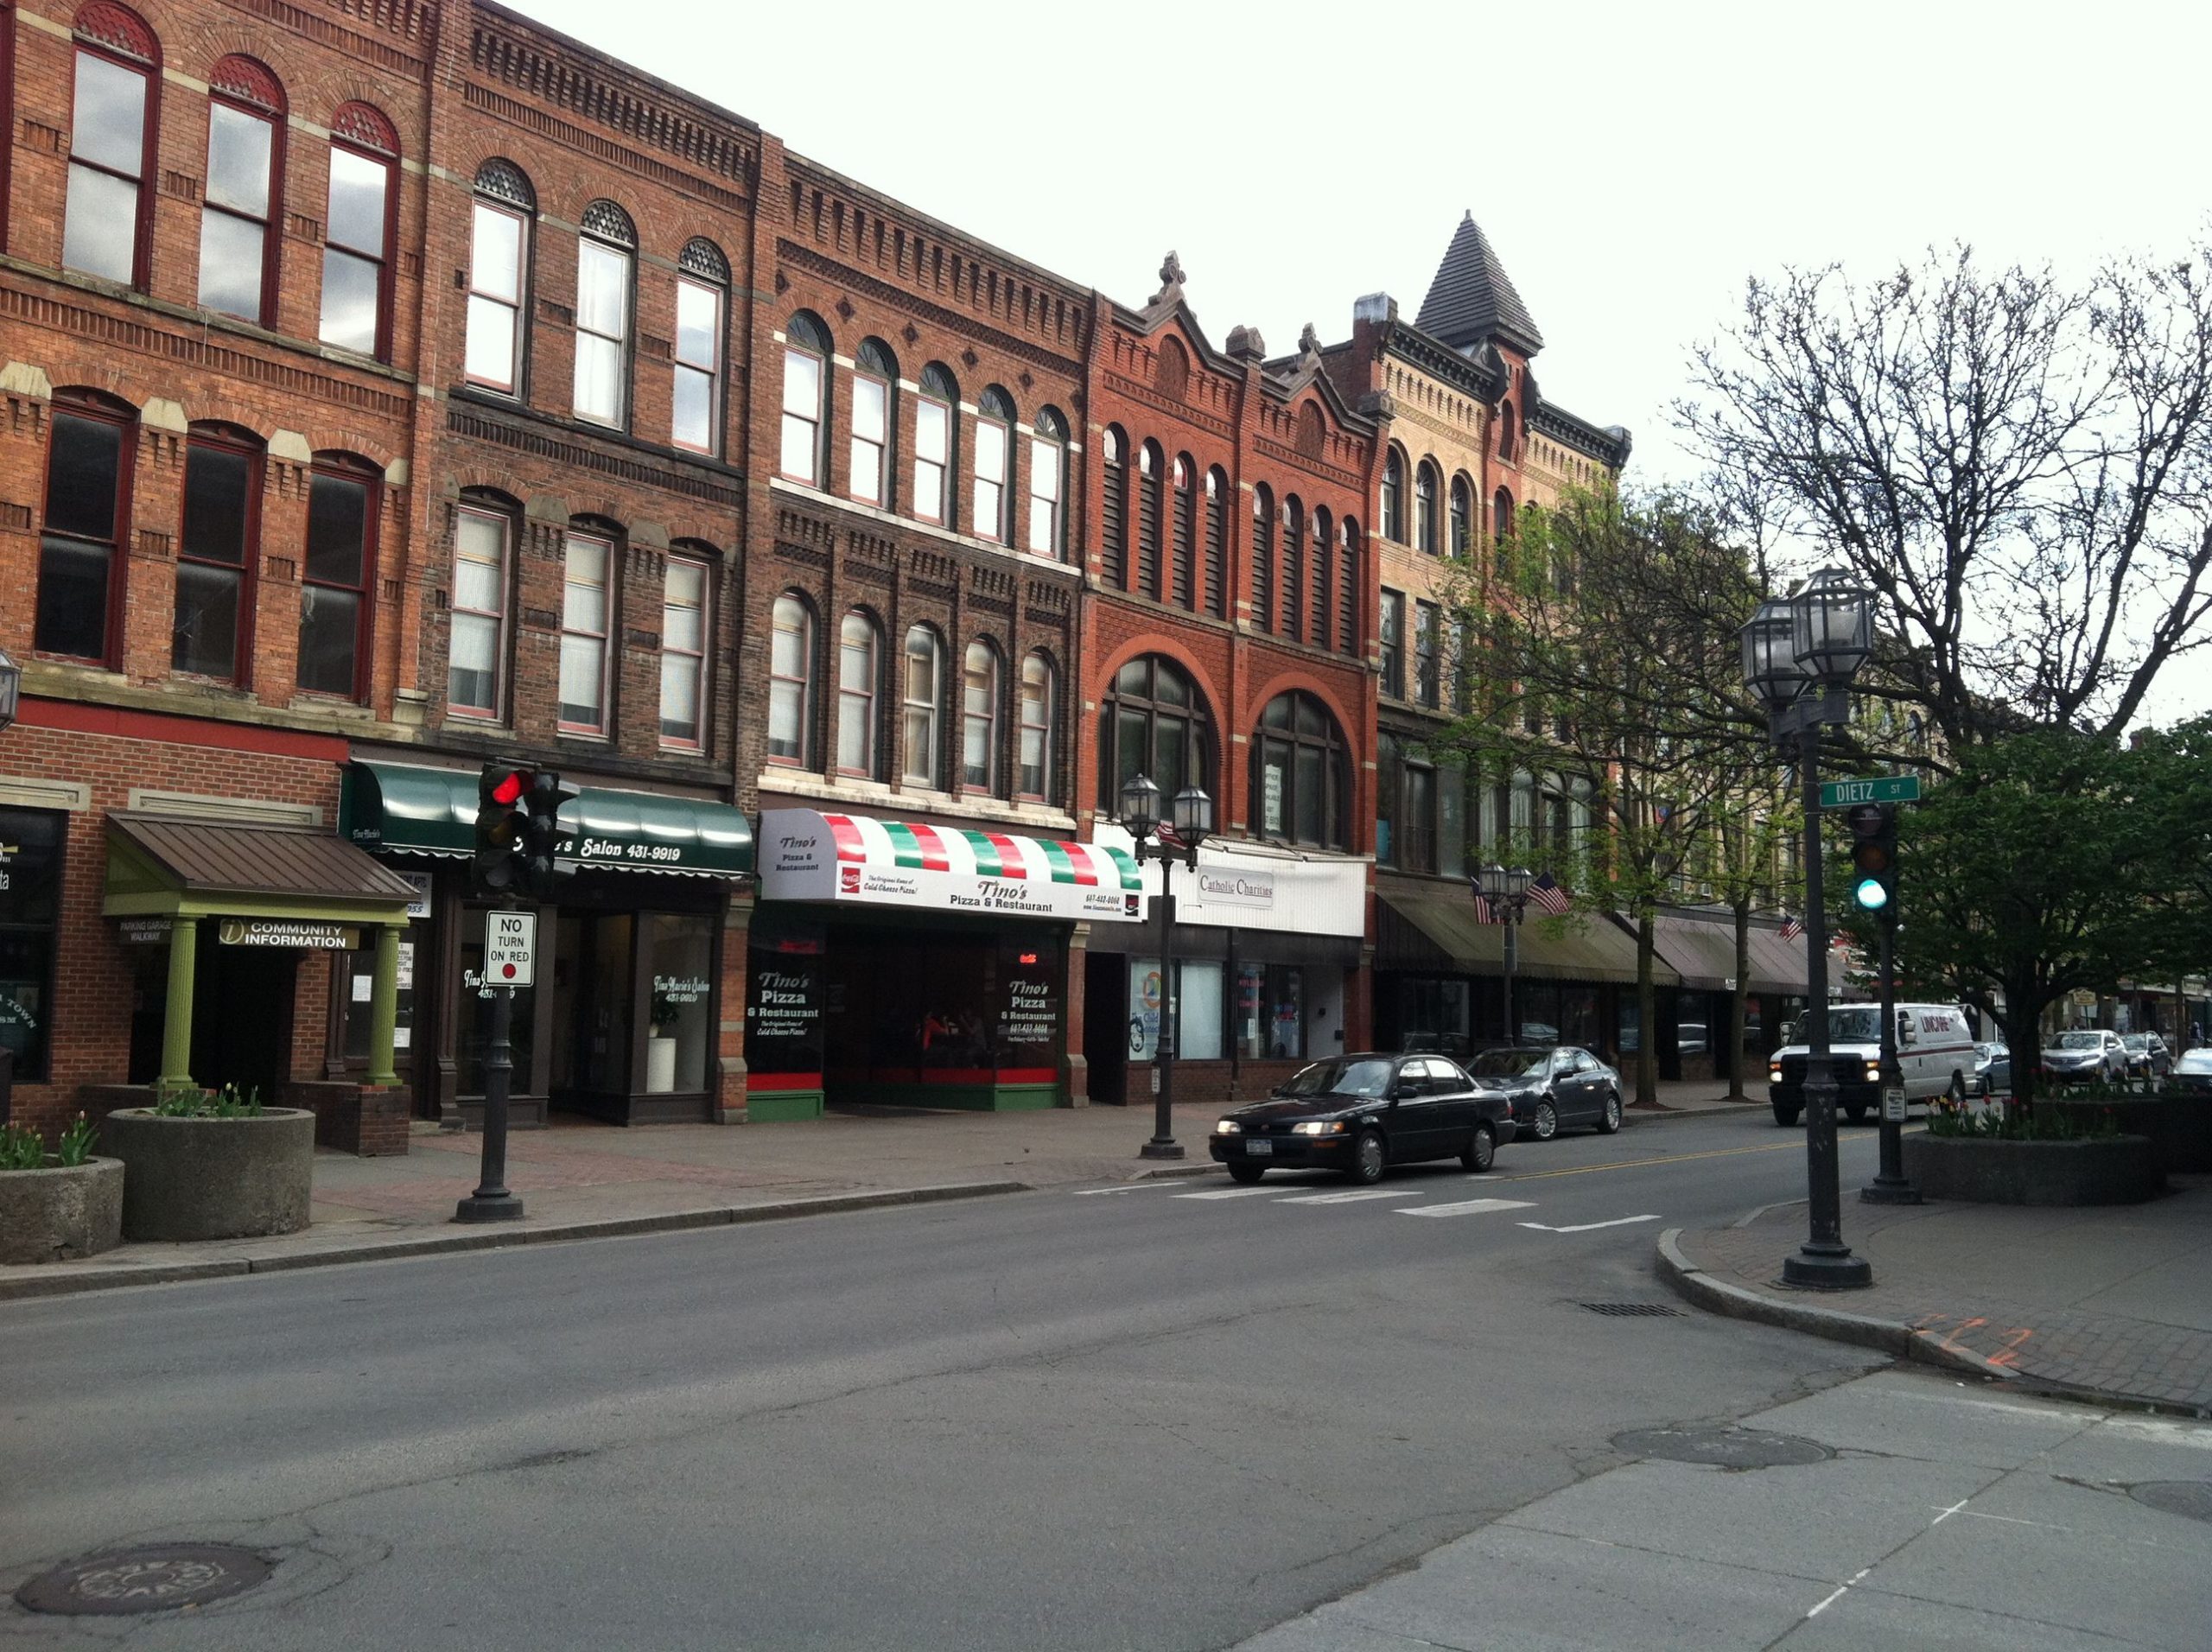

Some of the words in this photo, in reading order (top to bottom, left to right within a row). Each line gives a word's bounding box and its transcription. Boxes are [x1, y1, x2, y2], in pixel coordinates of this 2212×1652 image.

[1836, 782, 1875, 802] DIETZ
[1891, 784, 1901, 794] ST
[779, 836, 817, 848] Tino's
[581, 838, 621, 857] Salon
[626, 844, 681, 861] 431-9919
[776, 863, 819, 872] Restaurant
[977, 880, 1027, 899] Tino's
[1200, 874, 1235, 893] Catholic
[1236, 879, 1273, 896] Charities
[950, 894, 981, 906] Pizza
[984, 897, 992, 907] &
[995, 899, 1052, 912] Restaurant
[251, 922, 342, 936] COMMUNITY
[500, 918, 522, 932] NO
[245, 933, 346, 948] INFORMATION
[498, 936, 524, 947] TURN
[491, 950, 505, 962] ON
[510, 951, 530, 962] RED
[758, 971, 810, 988] Tino's
[1009, 980, 1049, 994] Tino's
[761, 990, 806, 1004] Pizza
[1011, 996, 1046, 1008] Pizza
[7, 999, 36, 1028] TOWN
[759, 1007, 819, 1018] Restaurant
[1010, 1012, 1056, 1020] Restaurant
